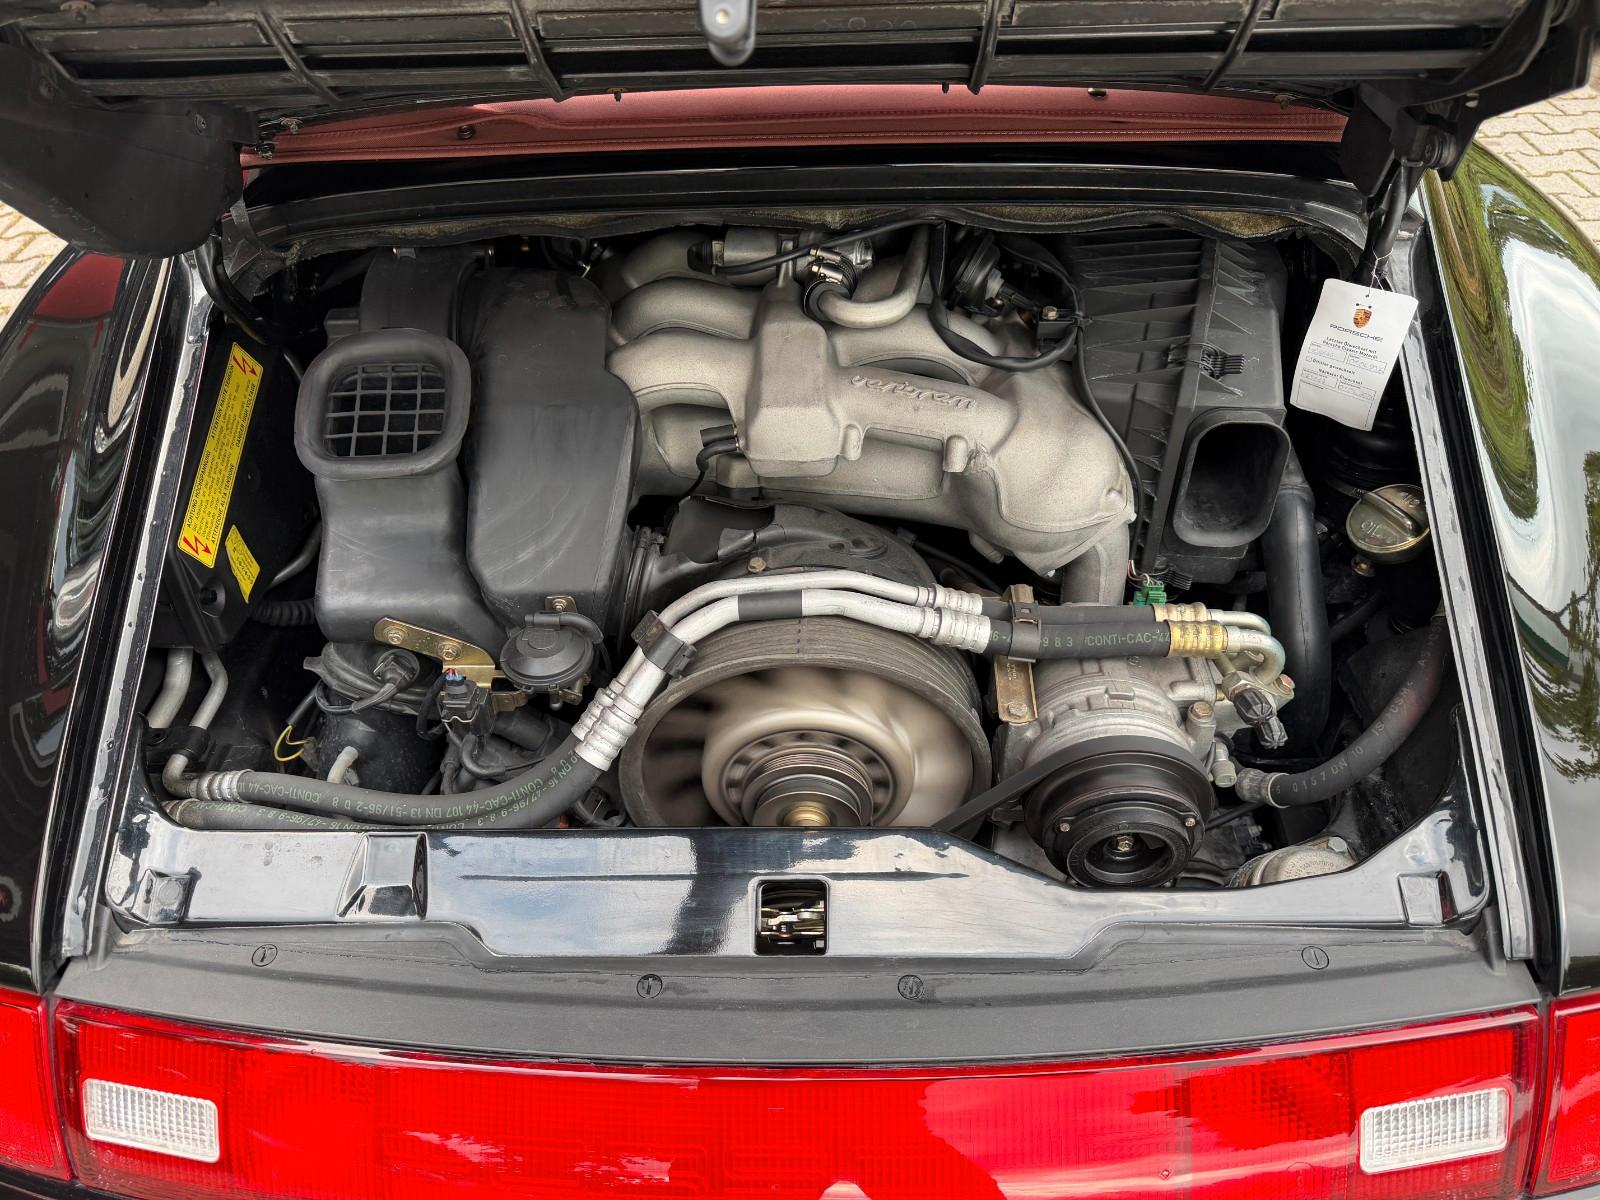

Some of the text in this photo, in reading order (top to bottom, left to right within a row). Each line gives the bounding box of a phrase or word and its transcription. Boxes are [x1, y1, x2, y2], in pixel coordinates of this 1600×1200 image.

[1329, 323, 1383, 342] PORSCHE
[210, 407, 222, 440] ATTENTION
[186, 498, 197, 528] ACHTUNG
[426, 807, 442, 818] DN
